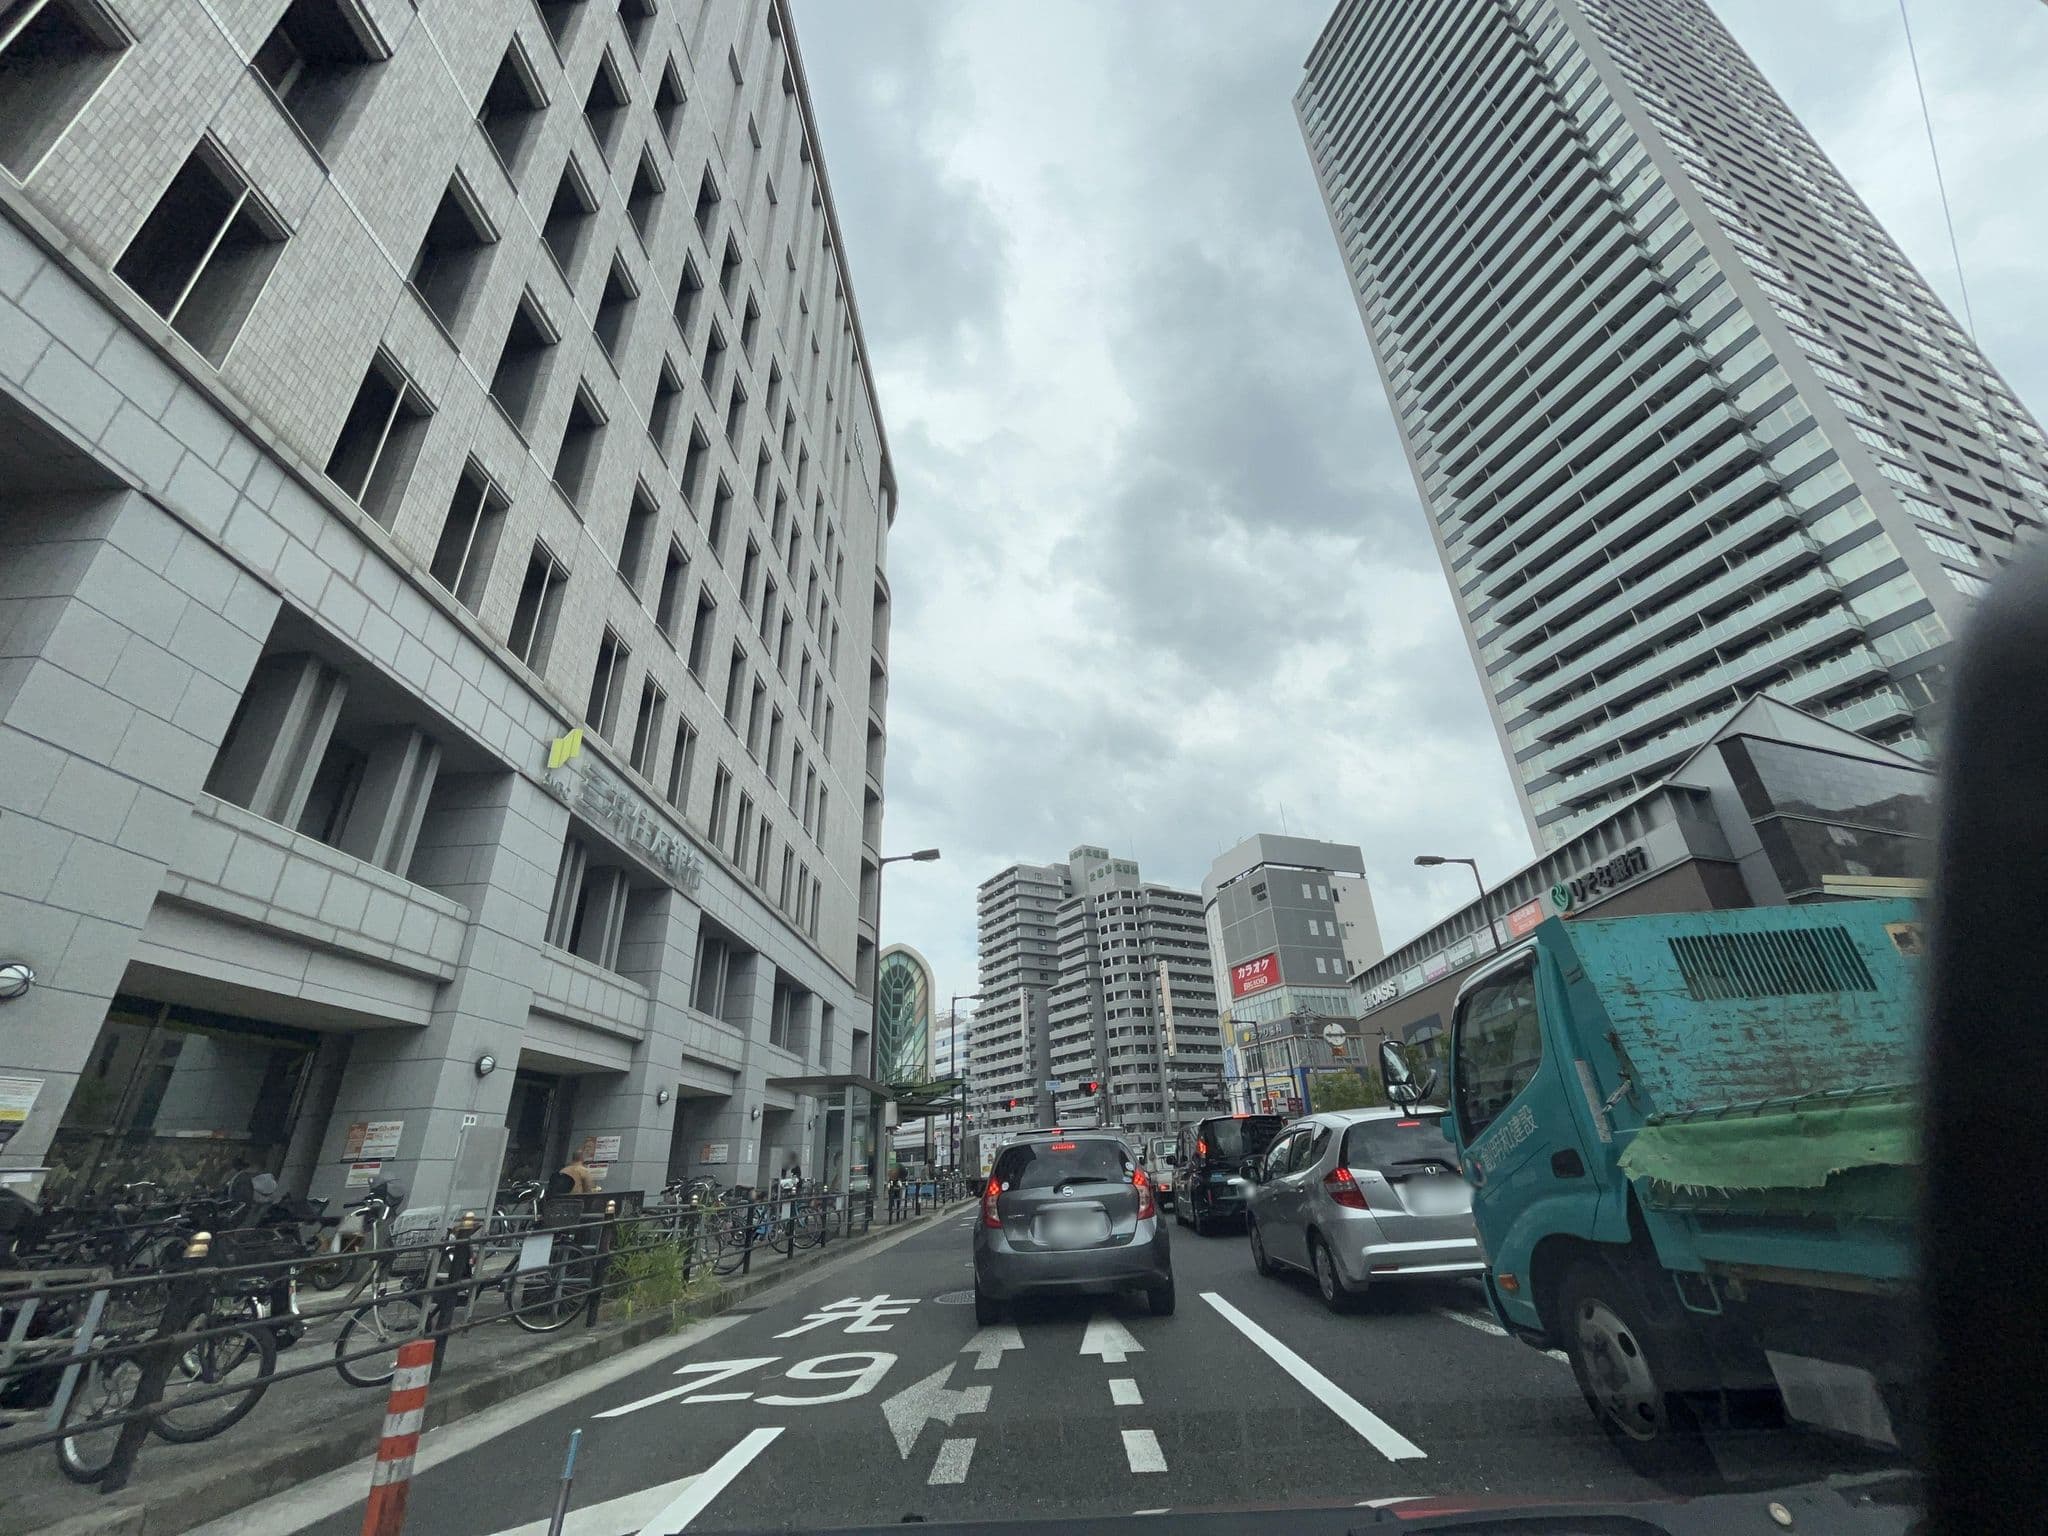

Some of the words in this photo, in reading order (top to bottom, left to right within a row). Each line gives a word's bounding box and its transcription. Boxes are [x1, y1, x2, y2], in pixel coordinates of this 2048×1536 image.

[576, 763, 704, 891] 三井住友銀行
[1570, 846, 1648, 902] りそな銀行
[1238, 959, 1269, 979] カラオケ
[772, 1294, 921, 1339] 先
